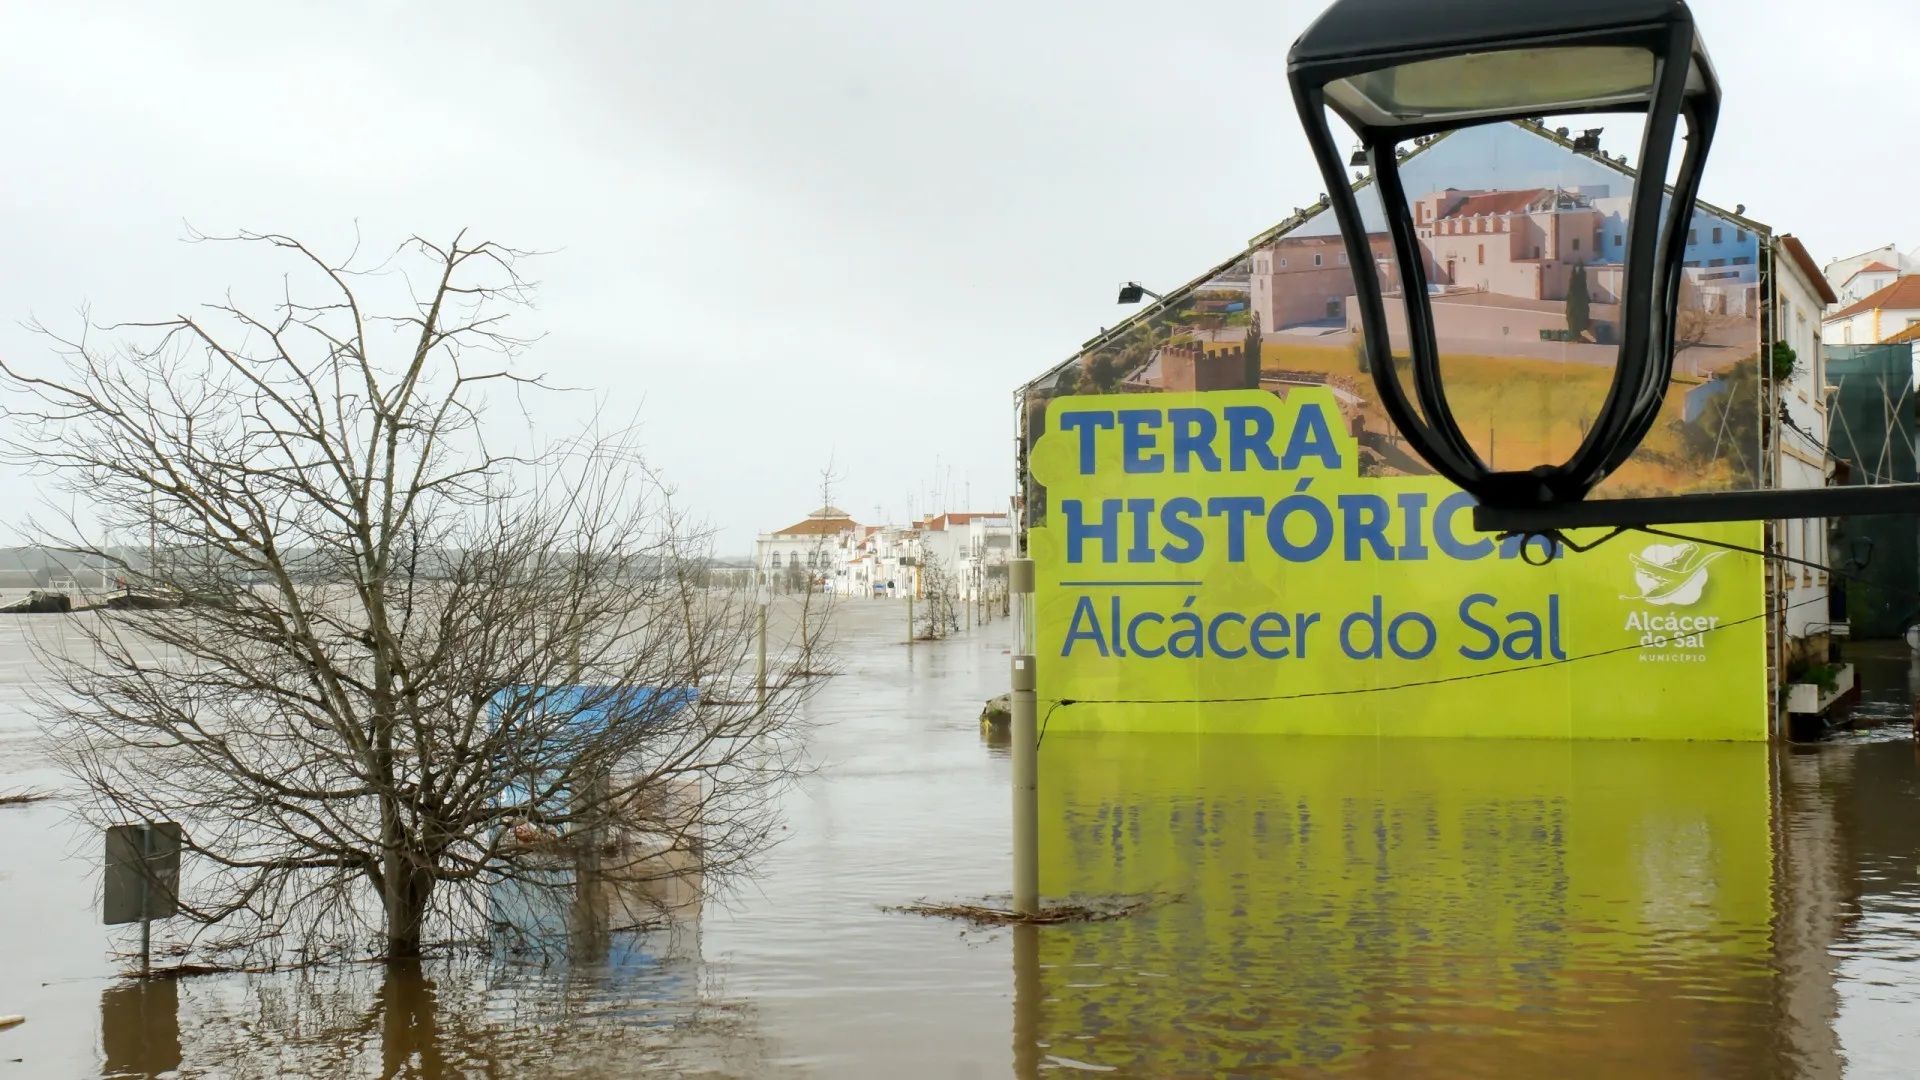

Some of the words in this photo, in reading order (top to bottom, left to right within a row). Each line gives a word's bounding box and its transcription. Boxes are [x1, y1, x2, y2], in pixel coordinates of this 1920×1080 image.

[1060, 403, 1341, 475] TERRA
[1060, 595, 1321, 659] Alcácer
[1339, 595, 1437, 660] do
[1458, 593, 1567, 660] Sal
[1624, 611, 1719, 631] Alcácer
[1640, 632, 1668, 648] do
[1673, 631, 1705, 648] Sal
[1639, 653, 1706, 662] MUNICÍPIO
